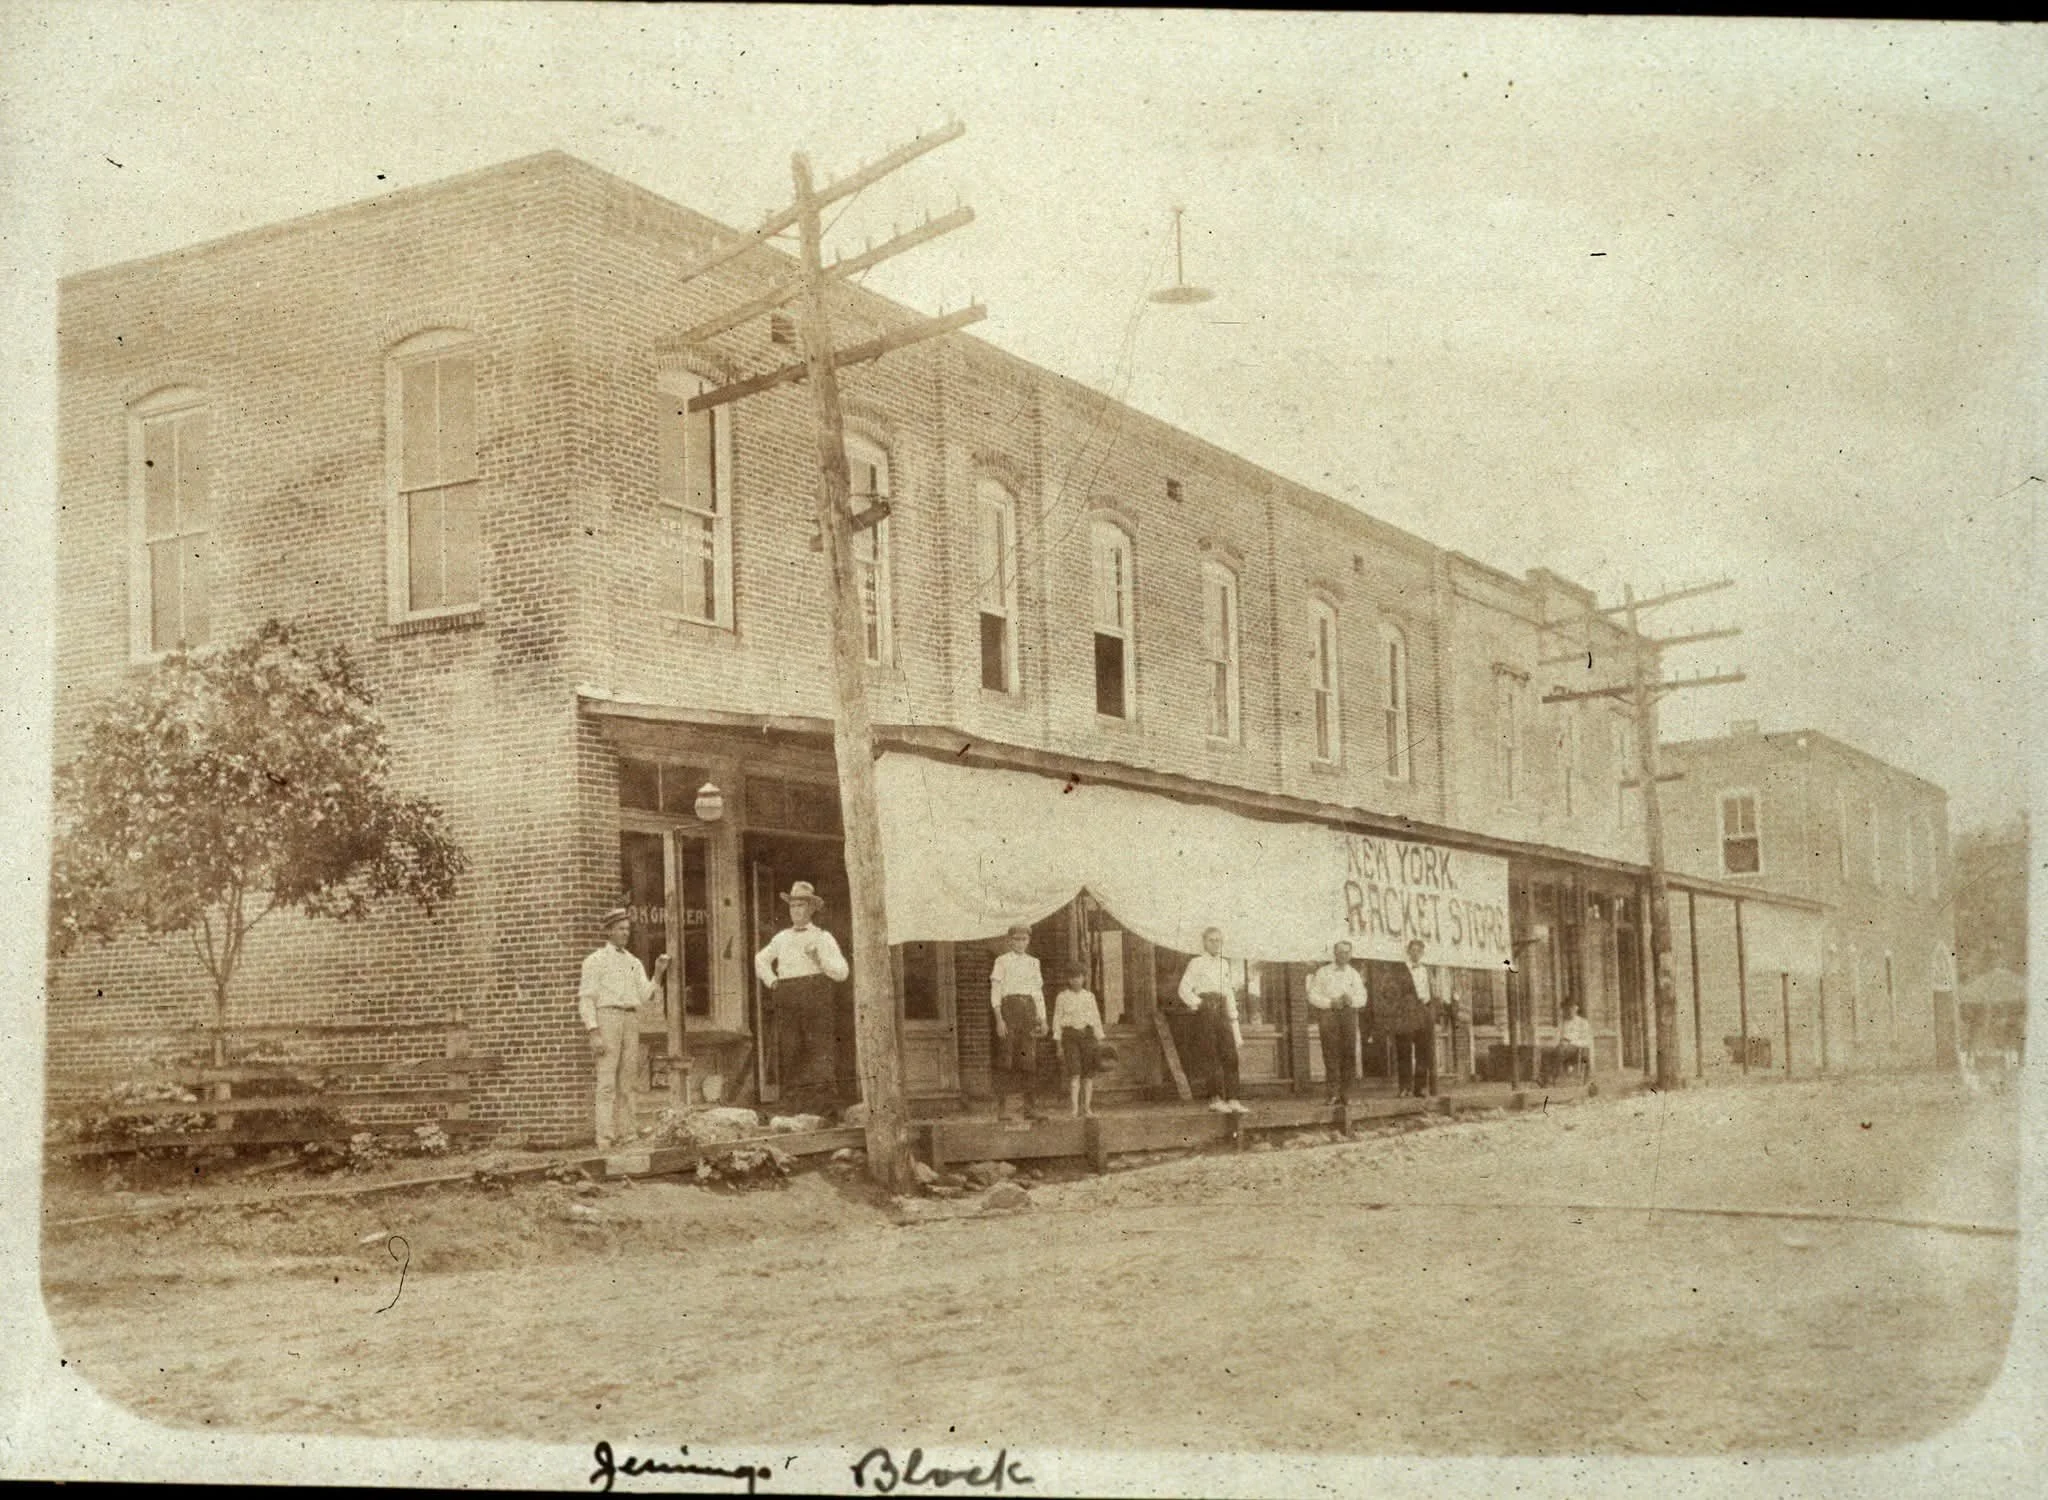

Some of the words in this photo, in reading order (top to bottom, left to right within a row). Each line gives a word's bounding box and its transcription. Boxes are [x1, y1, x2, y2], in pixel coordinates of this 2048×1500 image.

[1346, 836, 1391, 882] NEW
[1396, 843, 1458, 890] YORK
[1344, 880, 1441, 944] RACKET
[1450, 898, 1507, 953] STORE
[850, 1448, 1035, 1493] Block
